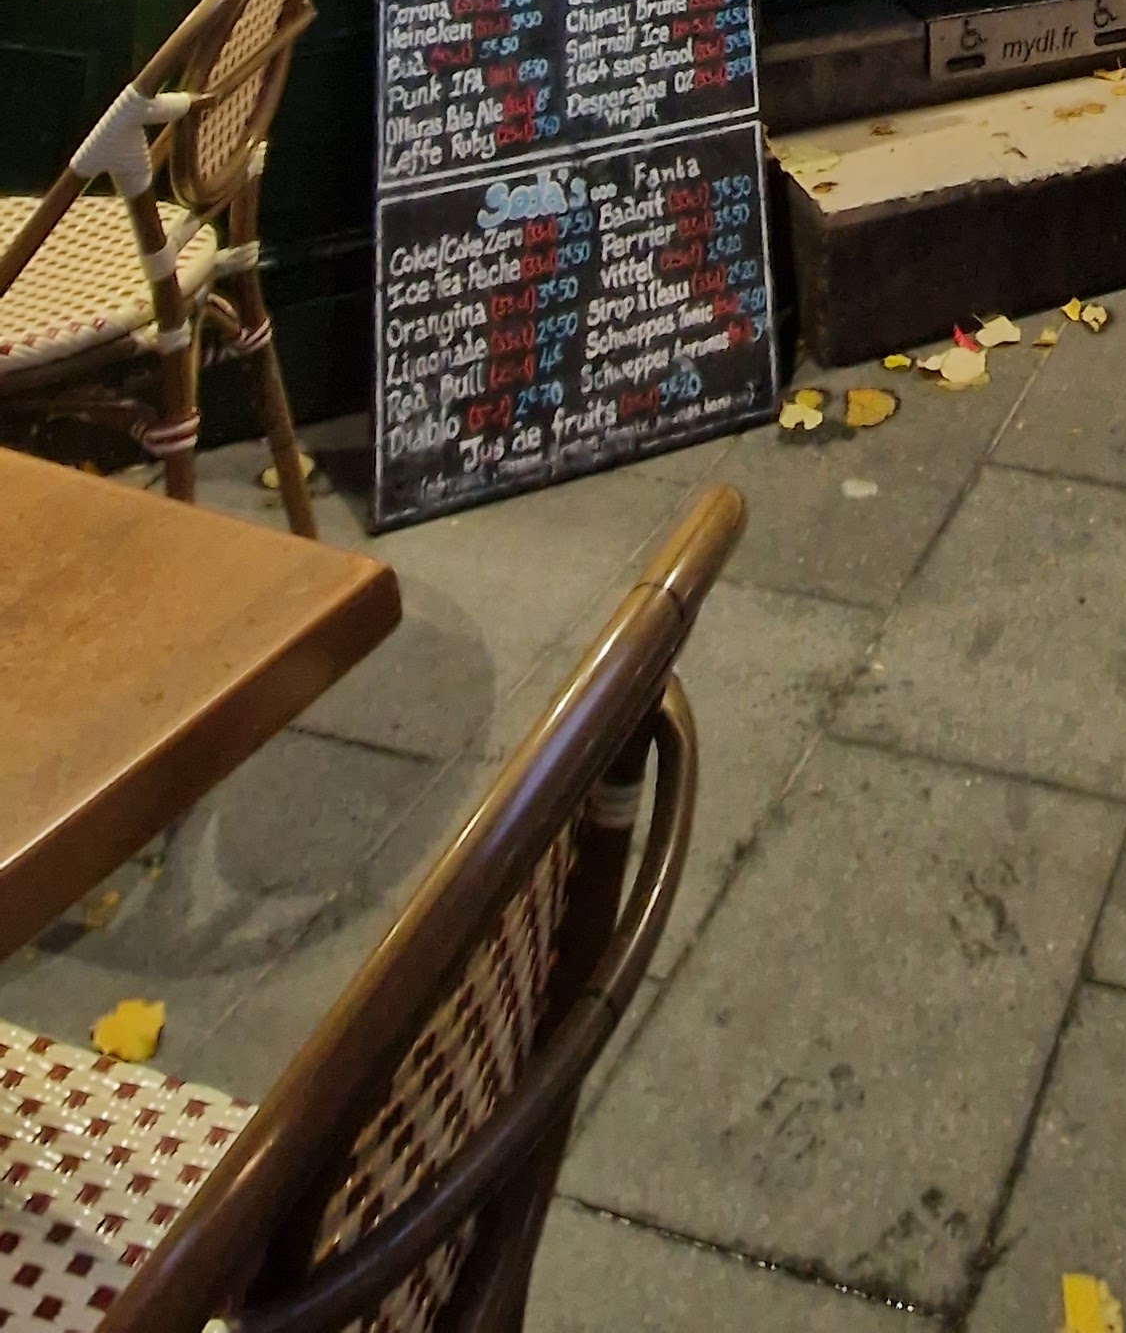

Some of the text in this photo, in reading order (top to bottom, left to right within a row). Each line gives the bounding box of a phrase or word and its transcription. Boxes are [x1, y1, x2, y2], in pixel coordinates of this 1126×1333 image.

[386, 0, 452, 26] Corona
[565, 3, 631, 34] Chimay
[387, 19, 473, 52] Heineken
[565, 25, 637, 65] Smirnoff
[639, 22, 671, 49] Ice
[1001, 25, 1079, 63] mydl.fr
[387, 50, 429, 83] Bud
[564, 58, 611, 90] 1664
[612, 55, 648, 79] sans
[648, 35, 694, 71] alcool
[387, 74, 442, 113] Punk
[448, 67, 486, 99] IPA
[567, 76, 667, 120] Desperados
[475, 97, 505, 129] Ale
[385, 137, 443, 177] Leffe
[450, 128, 497, 161] Ruby
[633, 156, 702, 191] Fanta
[599, 190, 667, 231] Badoit
[600, 219, 678, 263] Perrier
[387, 300, 489, 348] Orangina
[584, 312, 677, 361] Schweppes
[386, 329, 490, 386] Limonade
[580, 346, 671, 396] Schweppes
[386, 381, 429, 426] Red
[387, 414, 461, 458] Diablo
[458, 434, 505, 474] Jus
[511, 421, 543, 454] de
[551, 398, 619, 447] fruits
